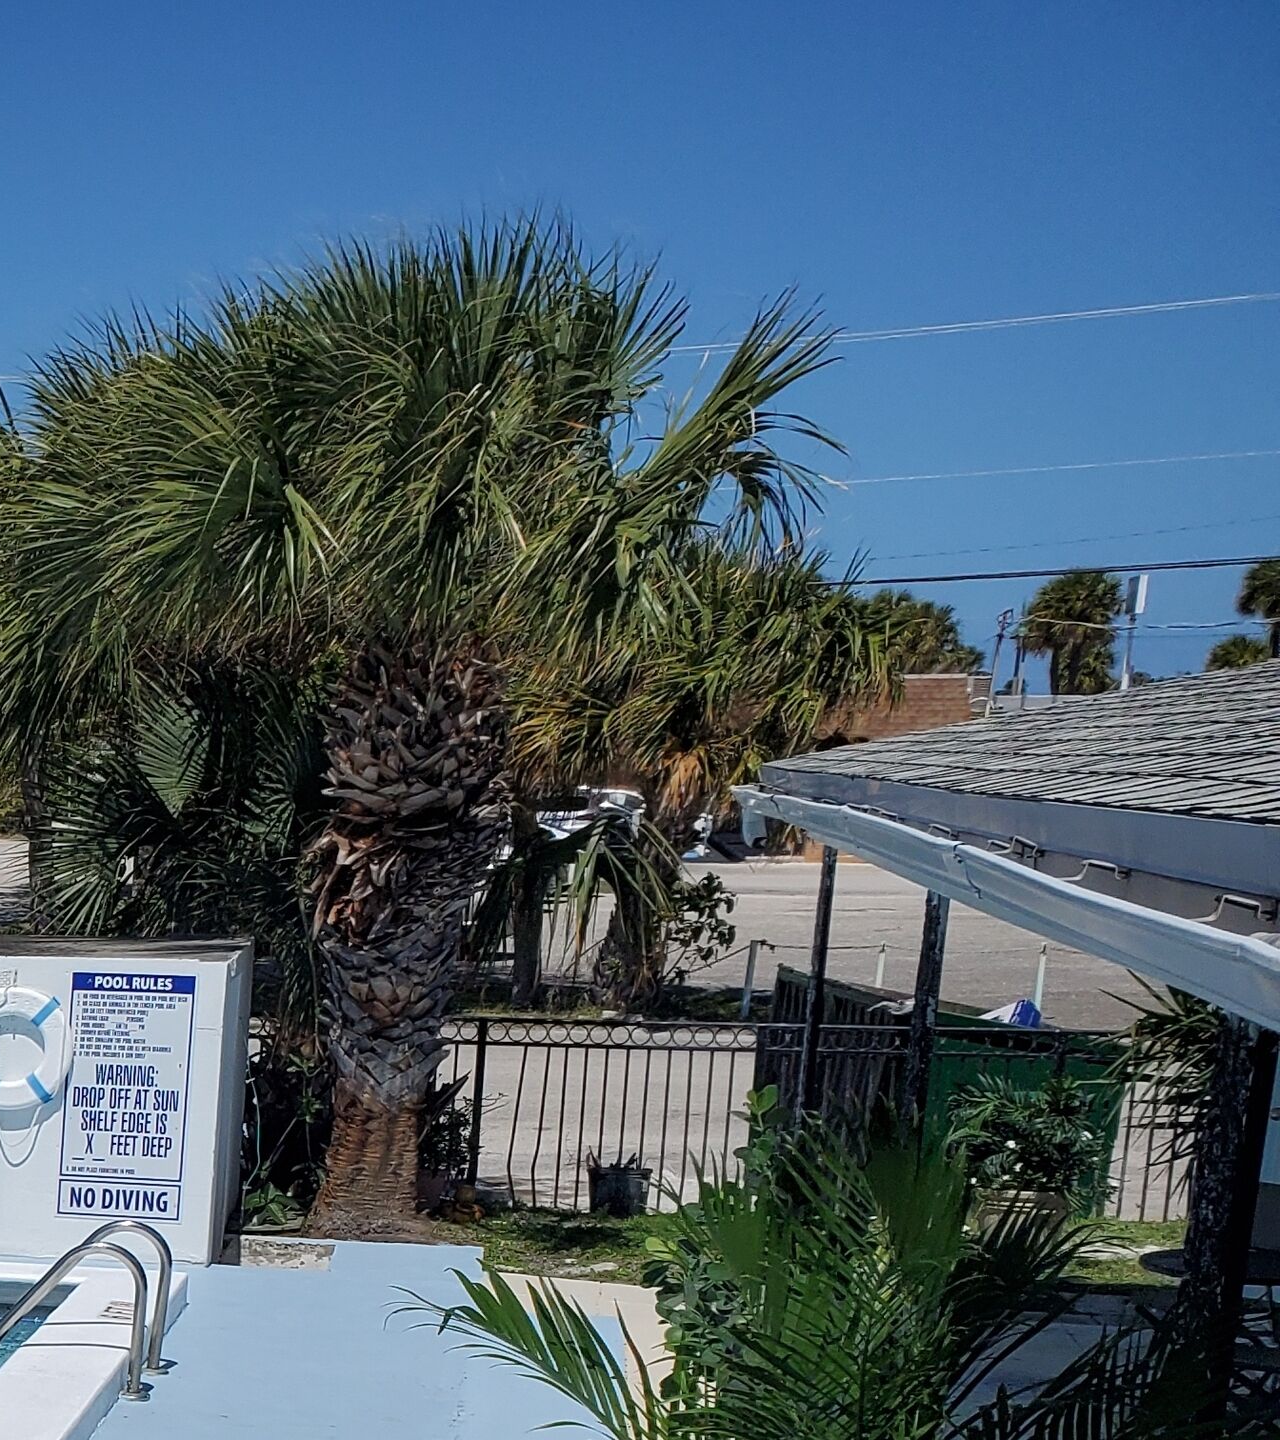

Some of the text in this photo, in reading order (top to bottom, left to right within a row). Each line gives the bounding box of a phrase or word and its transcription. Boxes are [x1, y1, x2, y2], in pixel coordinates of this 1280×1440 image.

[95, 975, 173, 991] POOL RULES
[96, 1064, 158, 1087] WARNING:
[72, 1086, 179, 1112] DROP OFF AT SUN
[80, 1110, 167, 1134] SHELF EDGE IS
[110, 1135, 138, 1156] FEET
[142, 1136, 172, 1158] DEEP
[70, 1187, 168, 1212] NO DIVING
